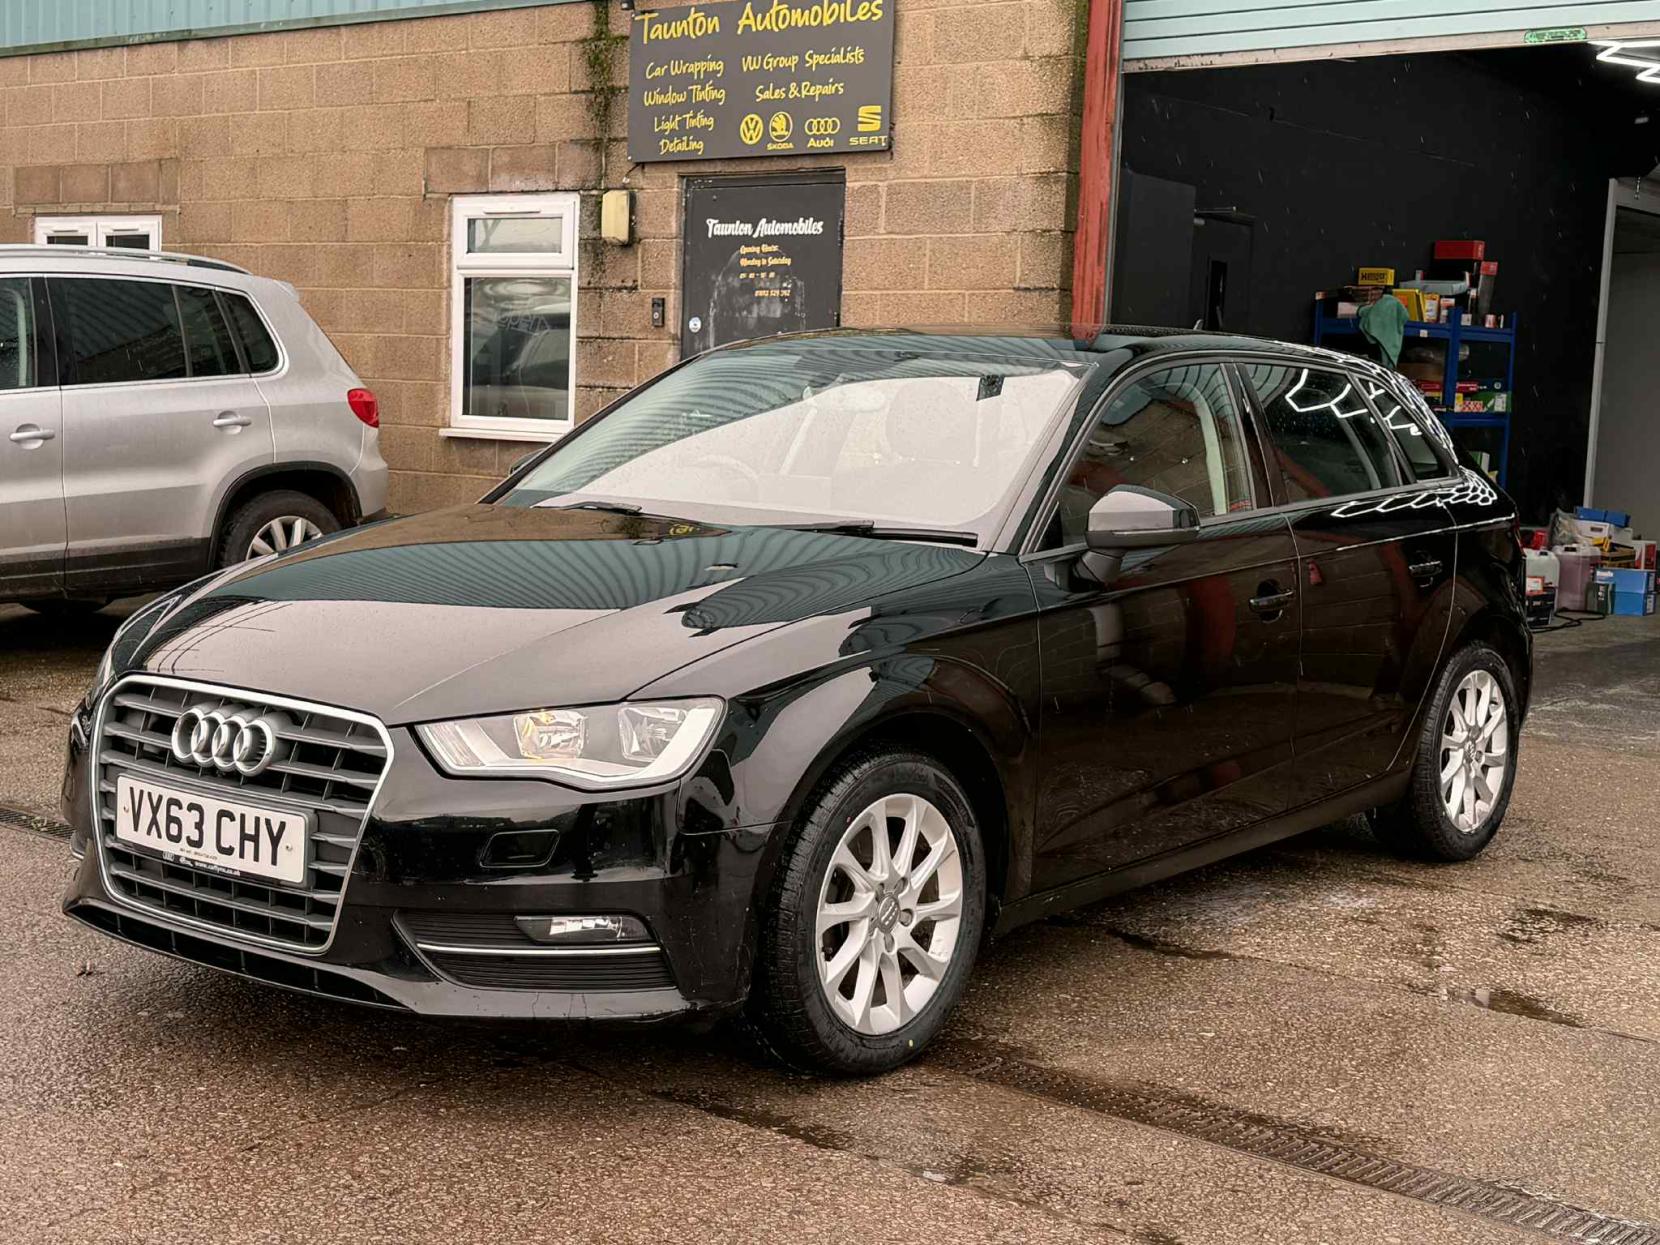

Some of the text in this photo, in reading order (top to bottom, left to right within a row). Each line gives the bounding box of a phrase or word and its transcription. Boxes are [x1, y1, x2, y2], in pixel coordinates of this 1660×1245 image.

[634, 0, 884, 45] Taunton Automobiles
[645, 55, 725, 80] Car Wrapping
[742, 47, 865, 73] VW Group Specialists
[643, 80, 726, 106] Window Tinting
[755, 78, 844, 103] Sales & Repairs
[654, 110, 715, 135] Light Tinting
[659, 136, 705, 155] Detailing
[807, 137, 834, 148] Audi
[849, 135, 888, 147] SEAT
[706, 217, 824, 239] Taunton Automobiles
[129, 786, 286, 866] VX63 CHY
